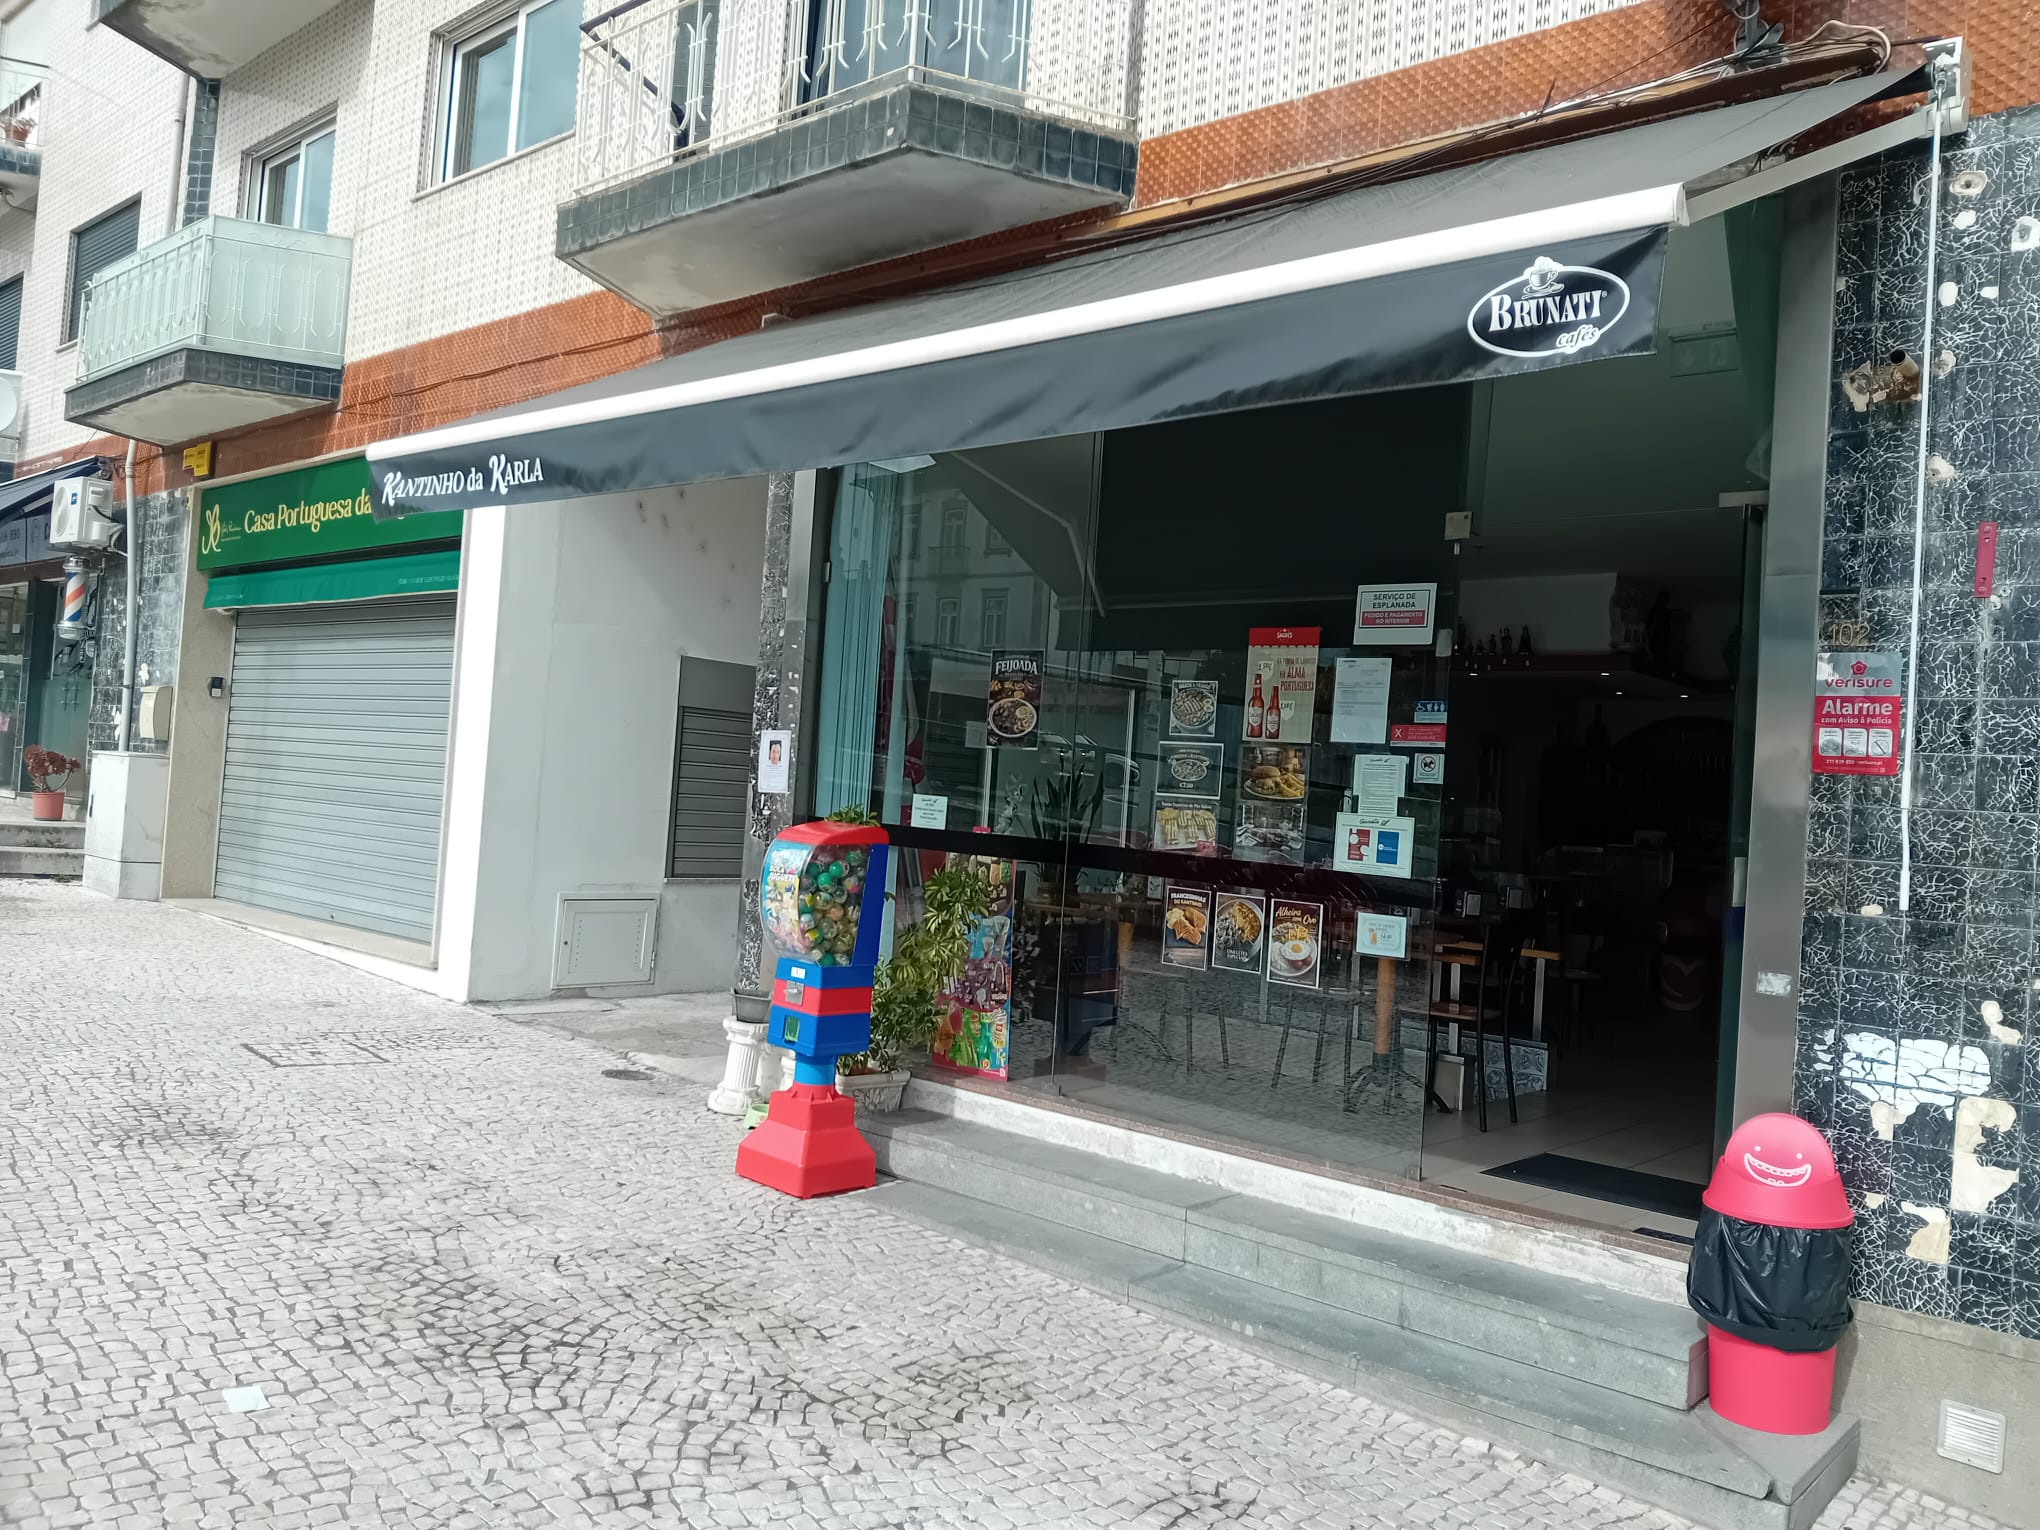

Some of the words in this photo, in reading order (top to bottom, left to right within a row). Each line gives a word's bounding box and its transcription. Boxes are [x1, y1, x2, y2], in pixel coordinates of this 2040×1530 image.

[1489, 290, 1602, 332] BRUNATI
[1558, 325, 1598, 350] cafés
[382, 471, 464, 506] KANTINHO
[467, 467, 483, 491] da
[489, 454, 544, 495] KARLA
[244, 510, 275, 533] Casa
[277, 499, 352, 533] Portuguesa
[355, 488, 372, 515] da
[1373, 593, 1404, 602] SERVIÇO
[1373, 601, 1416, 609] ESPLANADA
[1830, 623, 1870, 646] 102
[995, 659, 1038, 675] FEIJOADA
[1825, 677, 1893, 688] verisure
[1822, 699, 1893, 715] Alarme
[1838, 716, 1859, 724] Aviso
[1275, 906, 1301, 917] Alheira
[1302, 915, 1317, 925] Ovo
